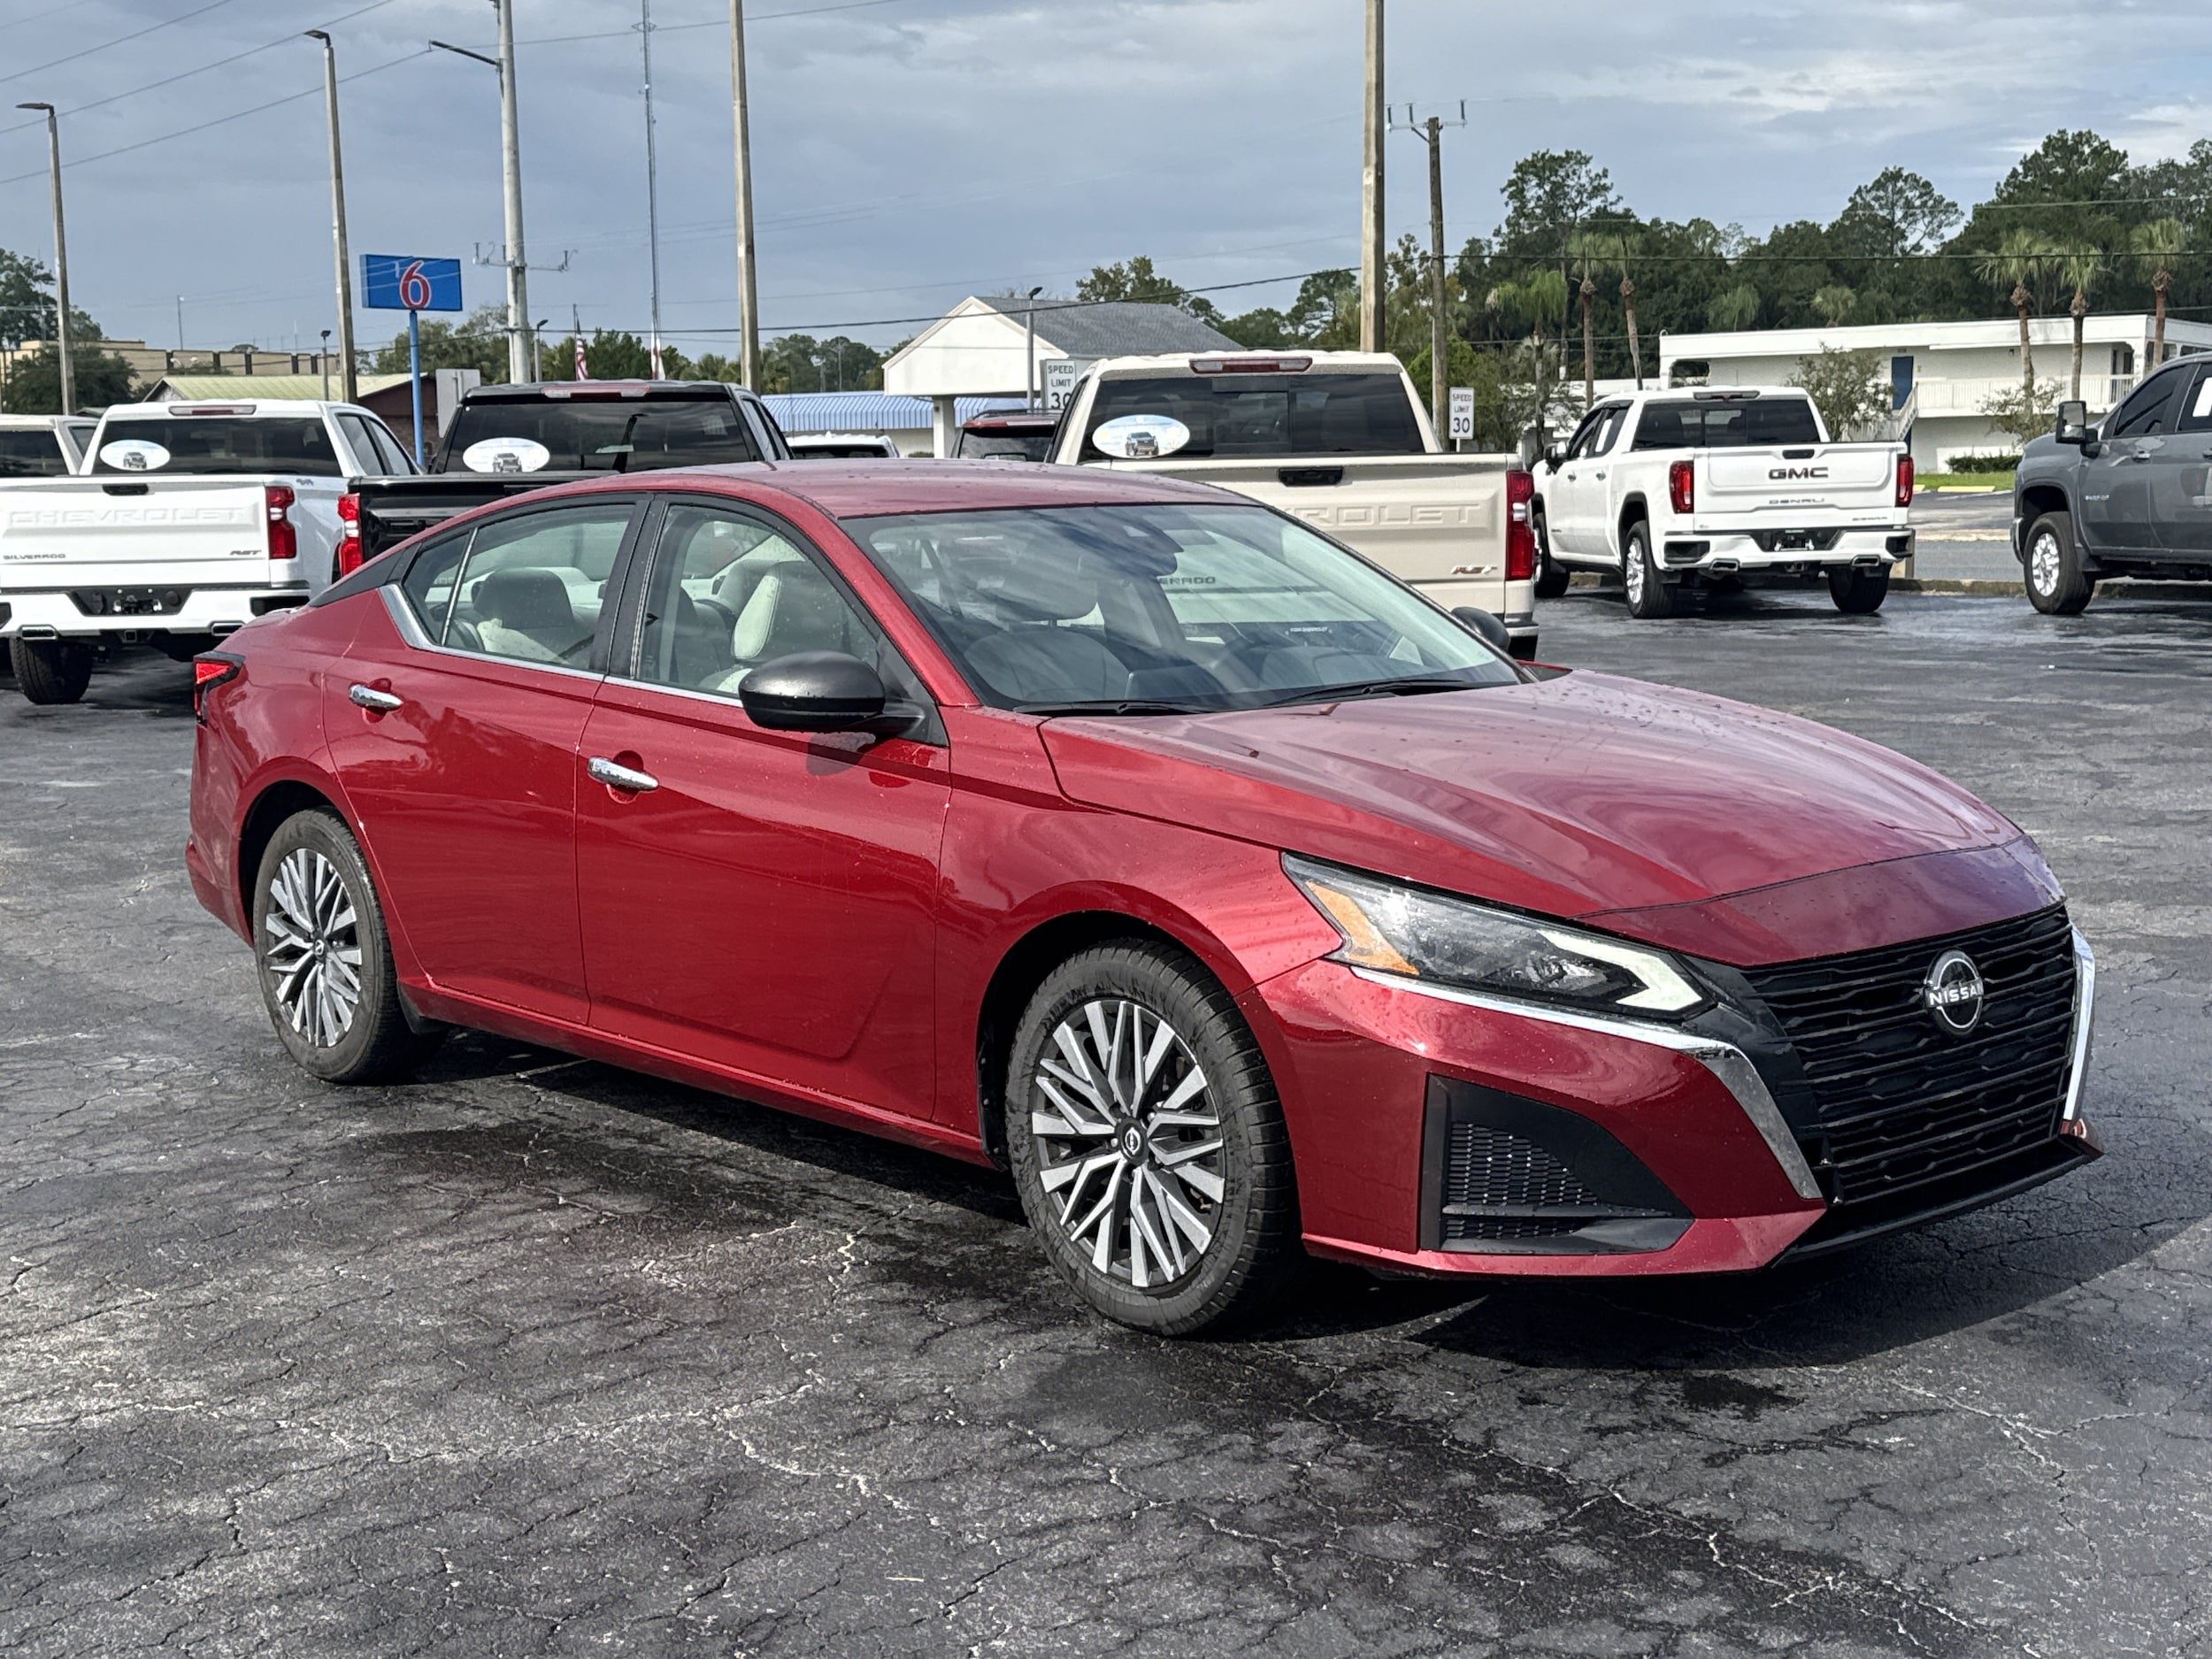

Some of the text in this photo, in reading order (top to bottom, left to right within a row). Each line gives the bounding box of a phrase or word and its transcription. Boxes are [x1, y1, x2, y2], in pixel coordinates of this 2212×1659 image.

[399, 259, 432, 309] 6
[1048, 365, 1074, 374] SPEED
[1050, 379, 1072, 388] LIMIT
[1453, 417, 1471, 434] 30
[1769, 467, 1829, 480] GMC
[9, 507, 245, 527] CHEVROLET
[1285, 503, 1480, 527] ROLET
[1929, 982, 1983, 1006] NISSAN
